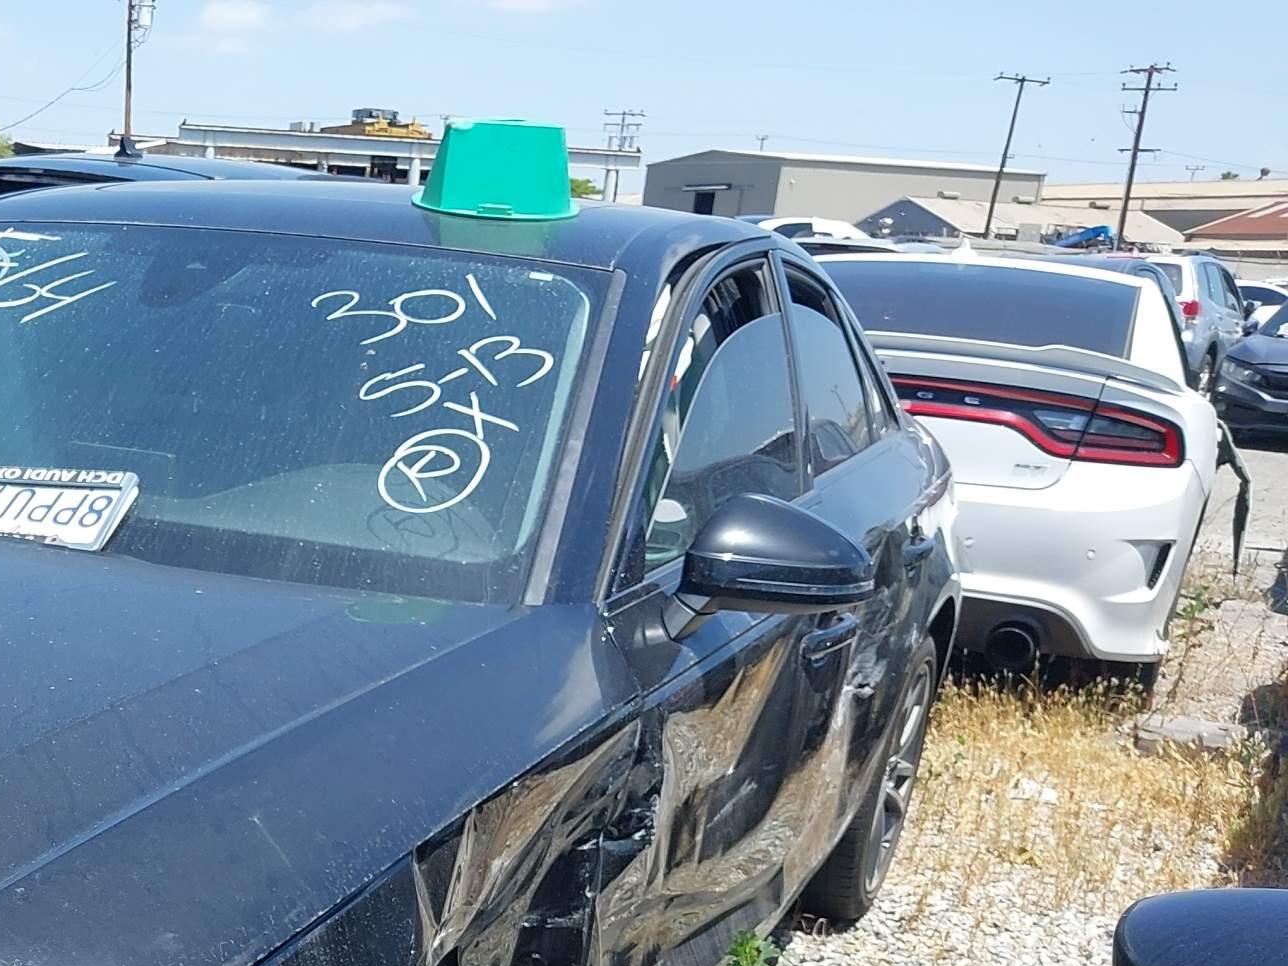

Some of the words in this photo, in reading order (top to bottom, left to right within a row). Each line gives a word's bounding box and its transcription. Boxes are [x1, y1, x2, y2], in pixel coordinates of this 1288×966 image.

[311, 273, 497, 345] 301
[23, 467, 74, 482] AUDI
[77, 470, 124, 484] DCH
